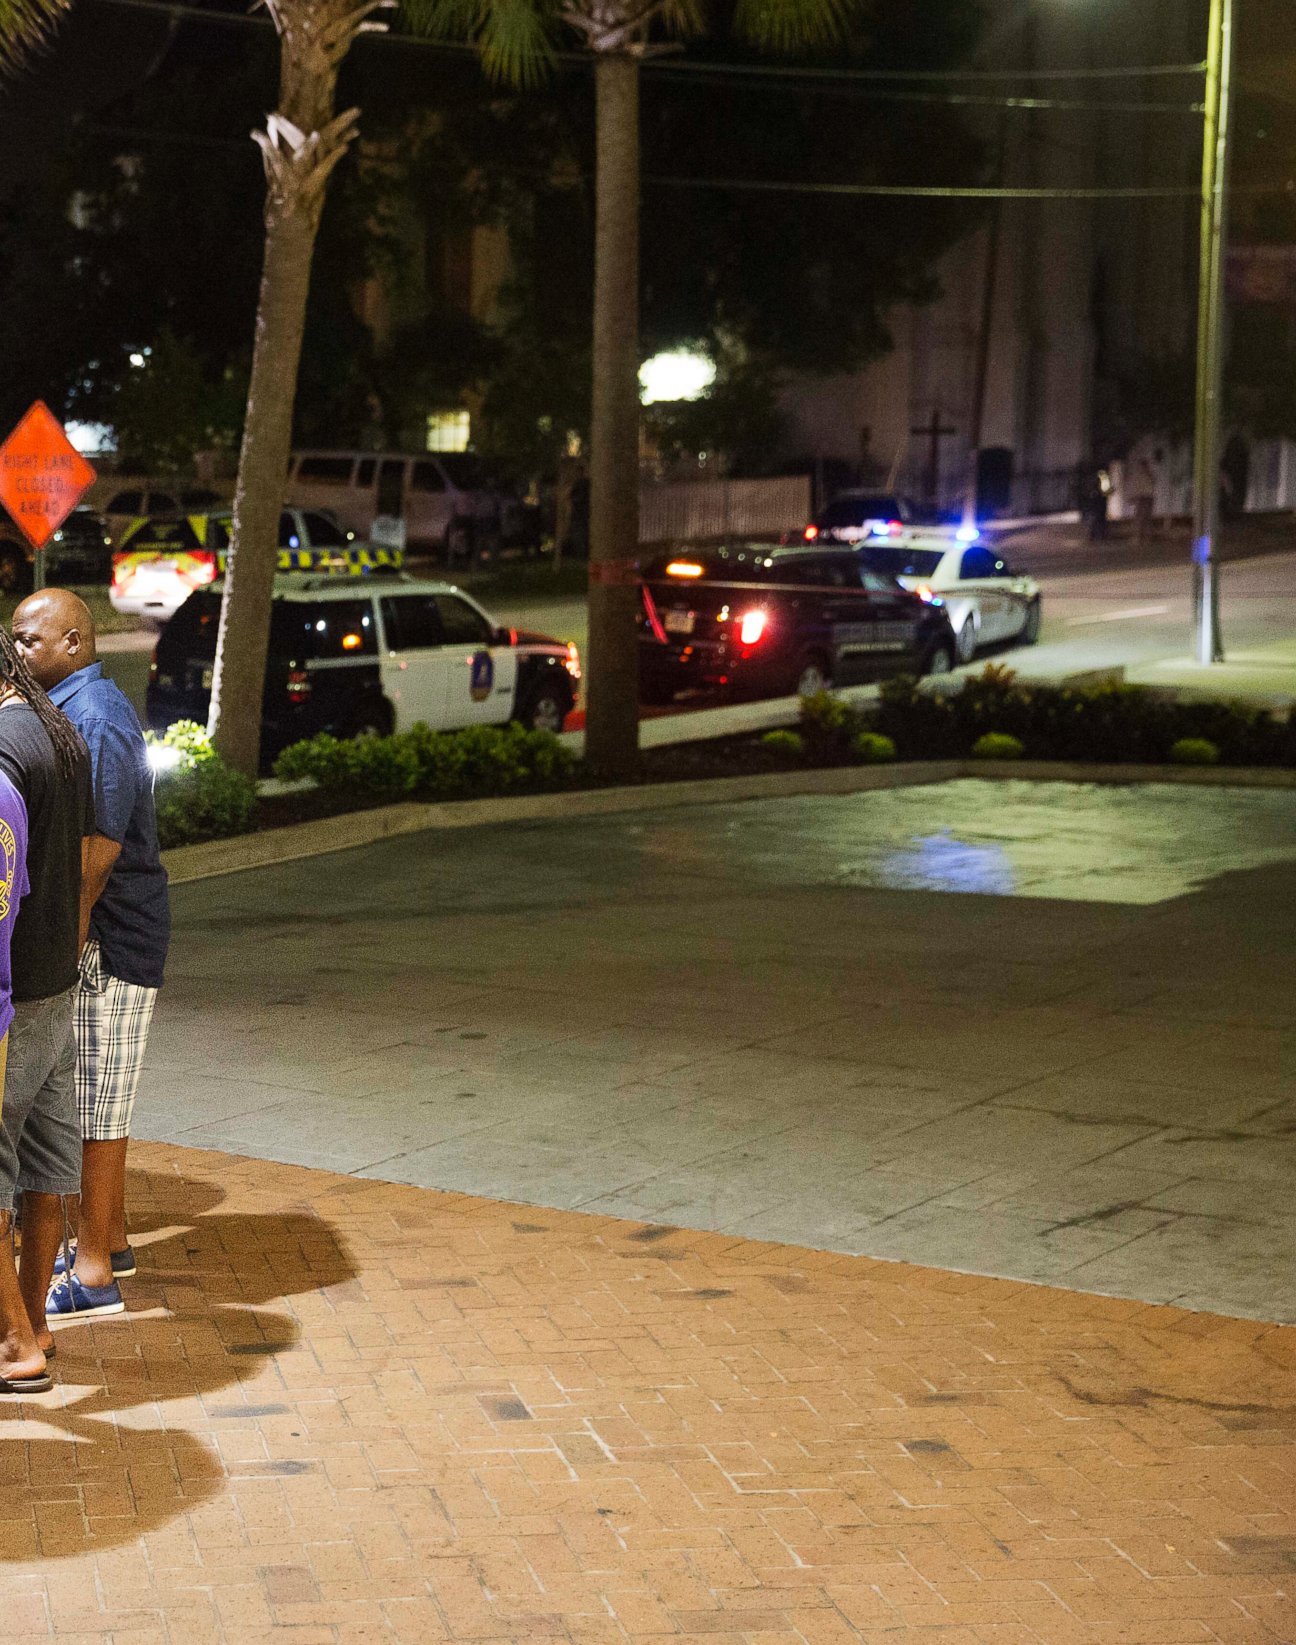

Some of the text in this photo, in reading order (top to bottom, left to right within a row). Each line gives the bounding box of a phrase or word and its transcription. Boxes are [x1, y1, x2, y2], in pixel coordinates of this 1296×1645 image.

[4, 455, 73, 471] RIGHT LANE
[16, 477, 64, 493] CLOSED
[20, 500, 60, 516] AHEAD
